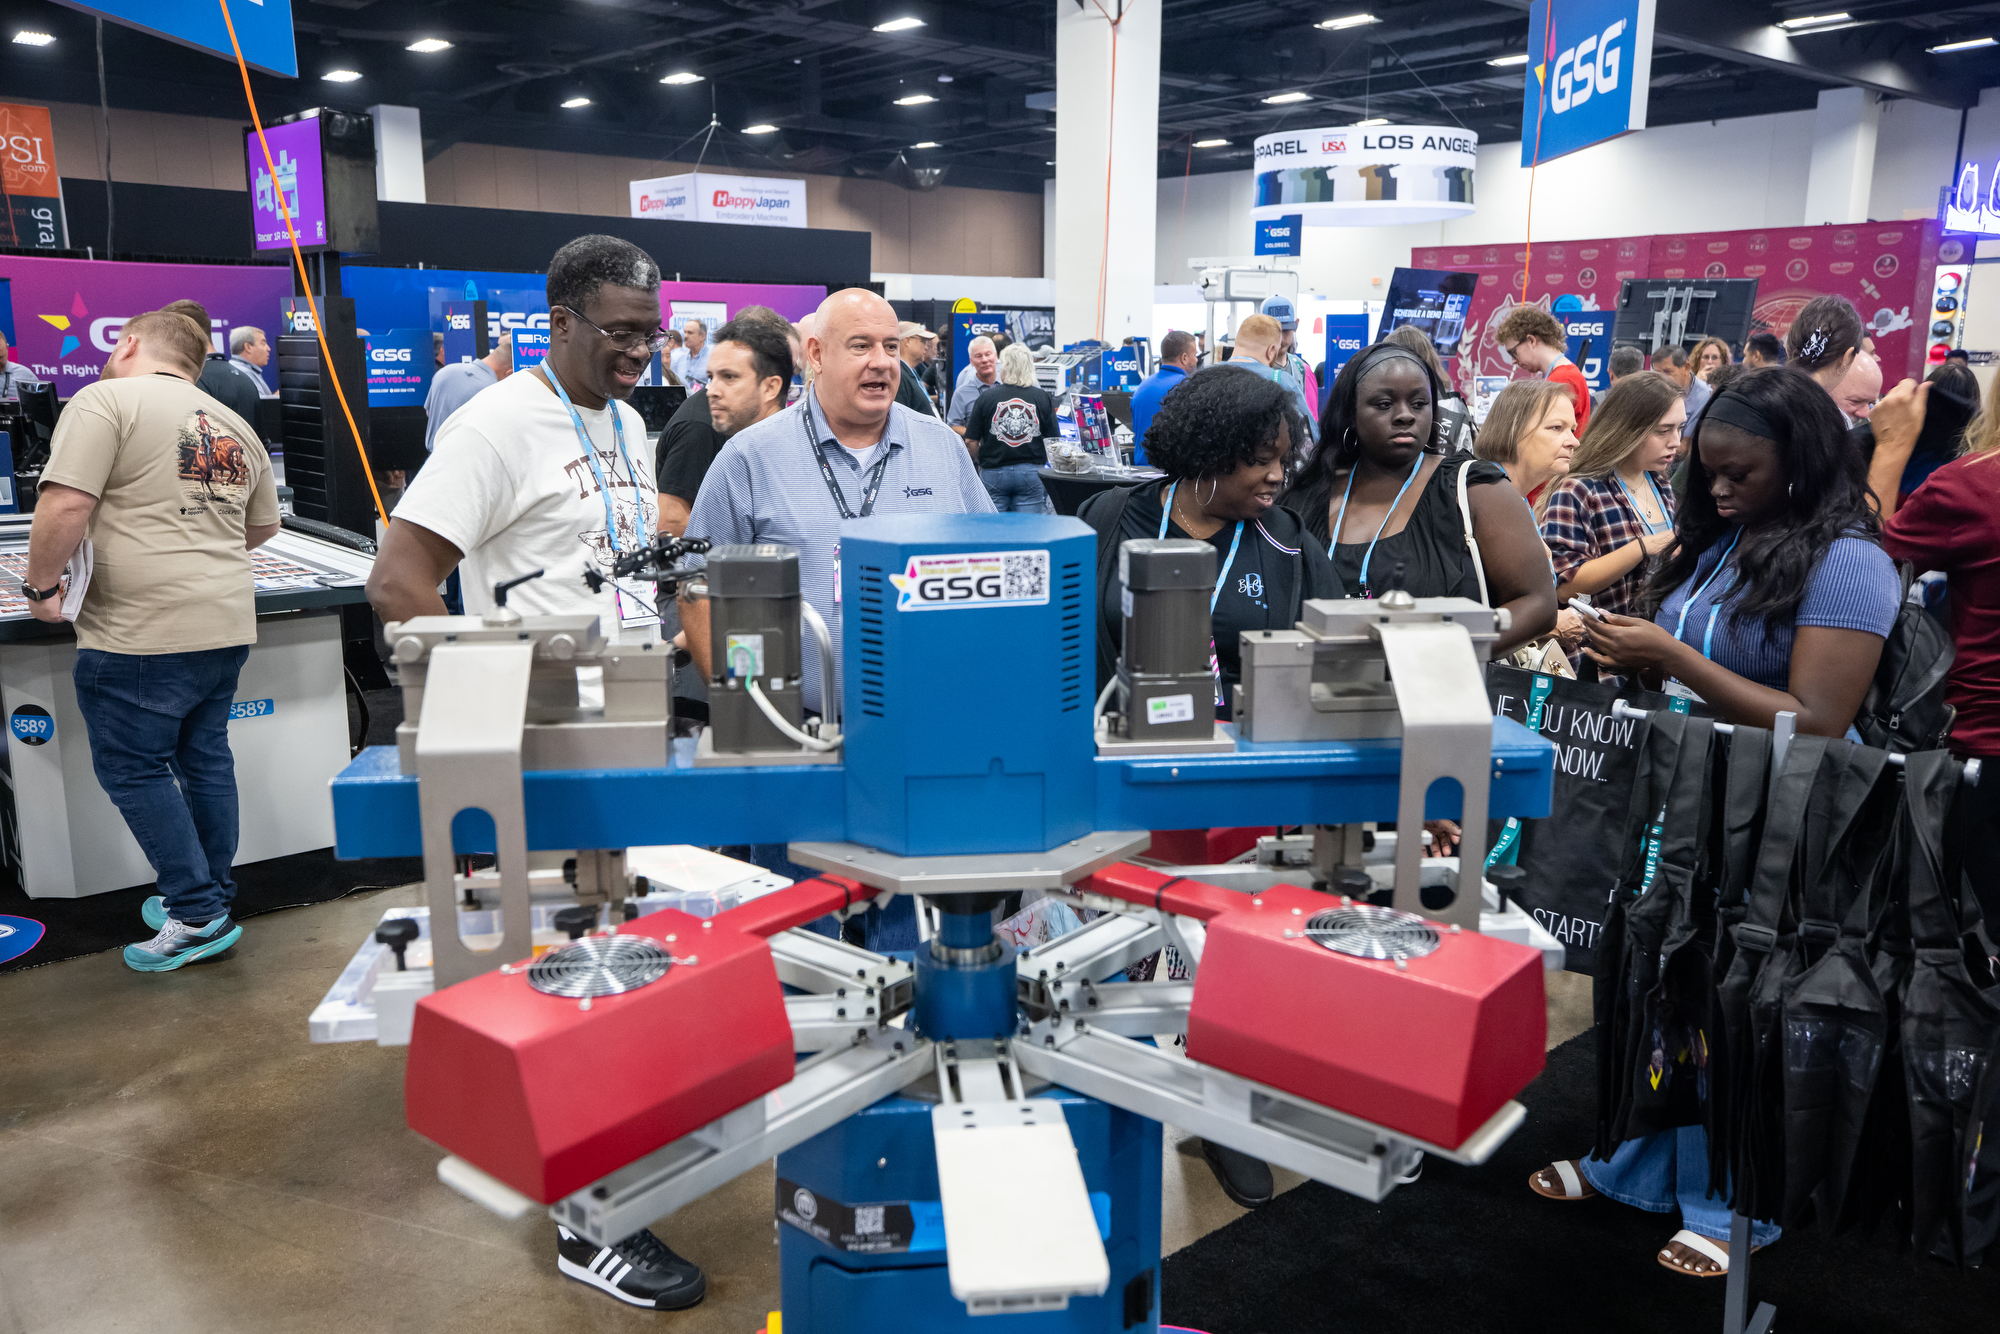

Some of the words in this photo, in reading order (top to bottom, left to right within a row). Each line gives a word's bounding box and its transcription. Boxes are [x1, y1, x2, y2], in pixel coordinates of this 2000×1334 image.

[1551, 20, 1622, 114] GSG
[1322, 141, 1346, 152] USA
[1364, 135, 1414, 149] LOS
[716, 211, 755, 222] Embroidery
[757, 213, 788, 222] Machines
[31, 208, 55, 248] gra
[1270, 227, 1290, 237] GSG
[1393, 308, 1421, 318] SCHEDULE
[1426, 311, 1441, 319] DEMO
[451, 315, 470, 329] GSG
[971, 323, 999, 335] GSG
[1567, 323, 1603, 336] GSG
[1338, 339, 1360, 349] GSG
[371, 348, 411, 361] GSG
[32, 364, 58, 375] The
[63, 364, 99, 378] Right
[1114, 360, 1137, 371] GSG
[911, 487, 932, 496] GSG
[919, 575, 1001, 601] GSG
[230, 700, 267, 718] $589
[1497, 694, 1514, 717] IF
[14, 719, 47, 734] $589
[1553, 743, 1607, 782] NOW...
